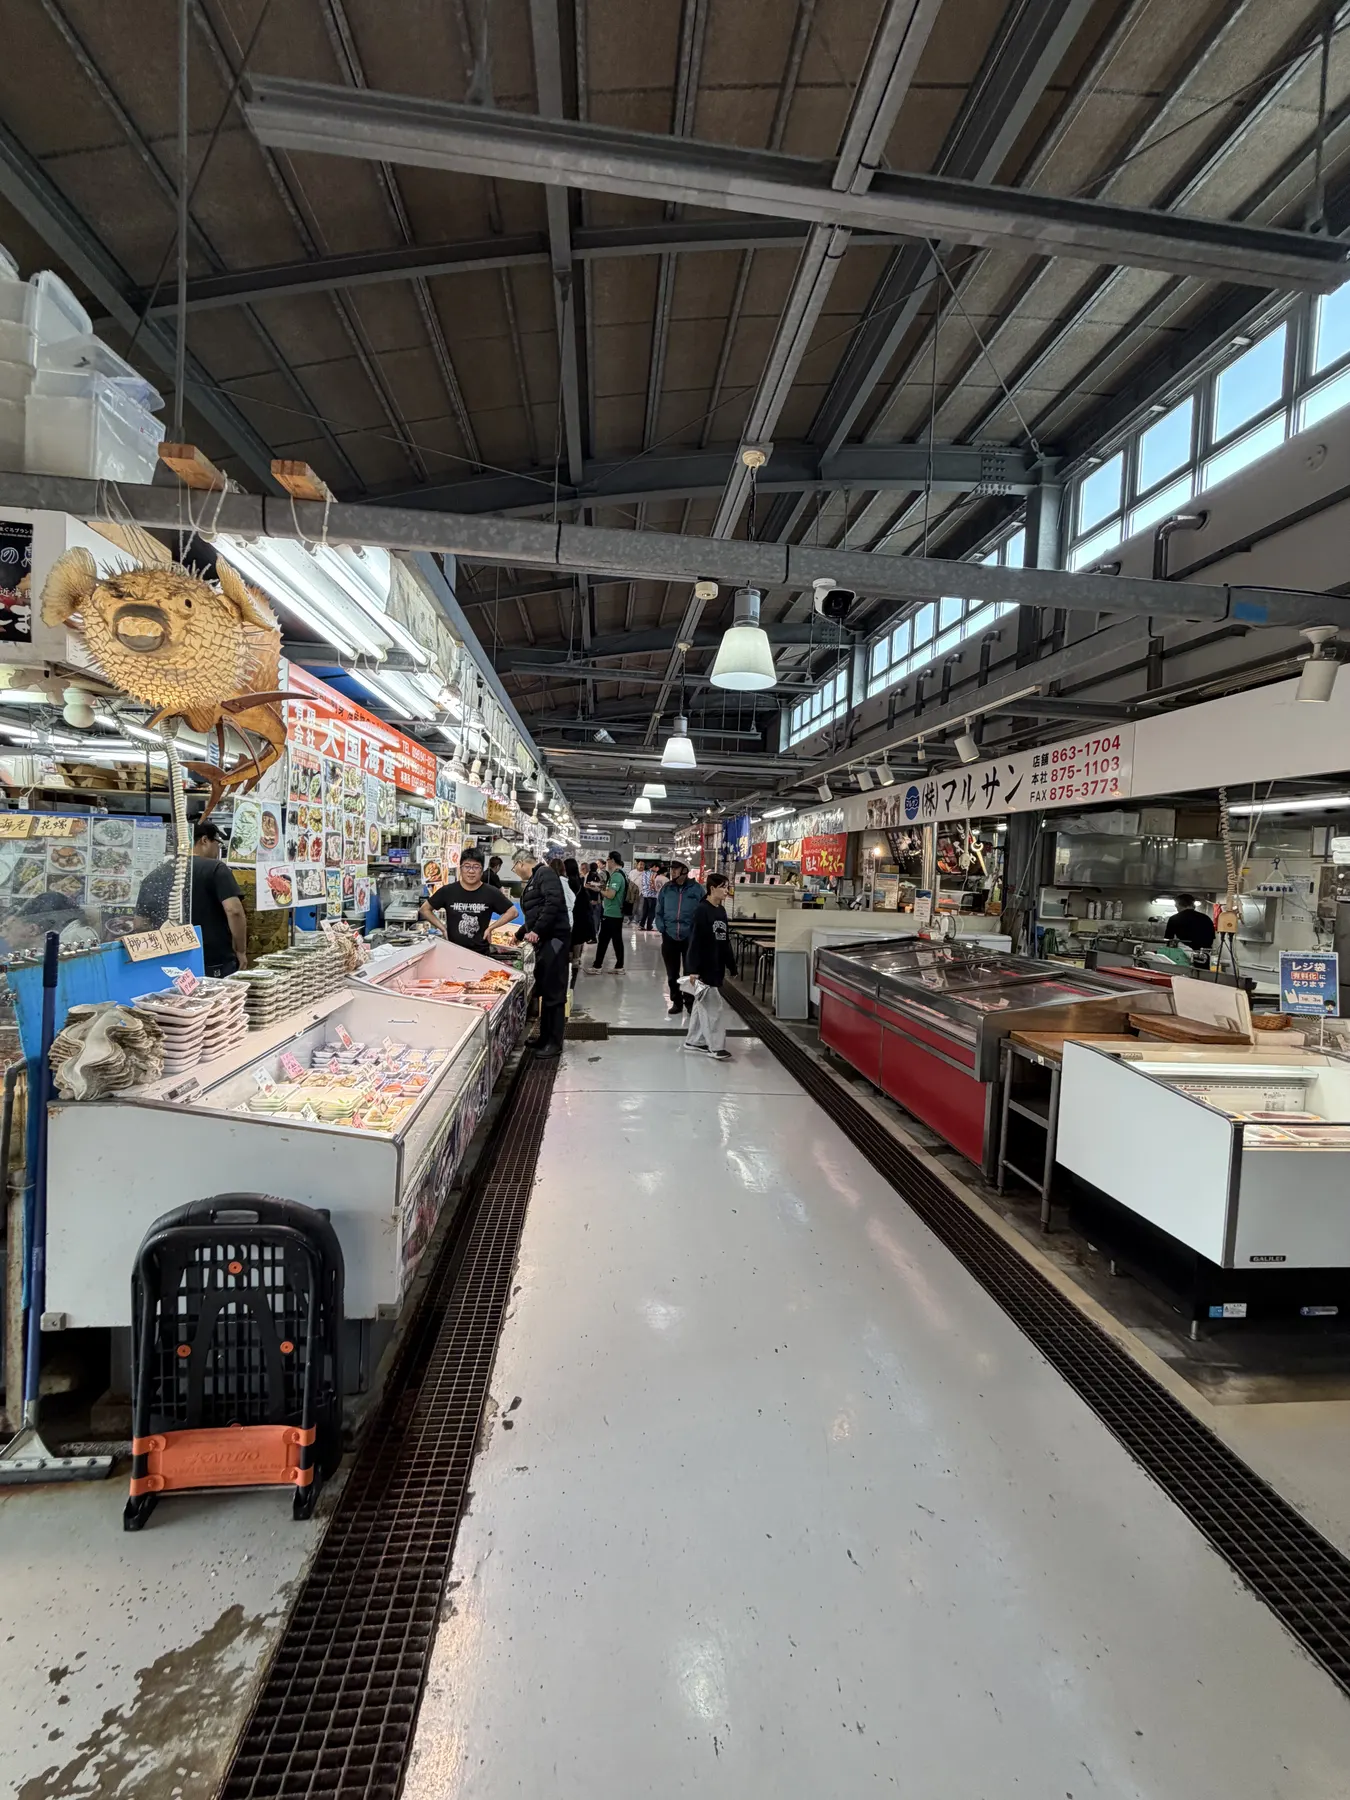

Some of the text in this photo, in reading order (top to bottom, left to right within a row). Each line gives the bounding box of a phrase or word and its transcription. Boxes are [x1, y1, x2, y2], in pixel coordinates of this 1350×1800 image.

[320, 718, 396, 781] 大国海産
[1032, 735, 1121, 768] 店舗 863-1704
[1031, 756, 1120, 785] 本社 875-1103
[1030, 777, 1119, 802] FAX 875-3773
[453, 902, 486, 911] NEW YORK
[1292, 961, 1327, 972] レジ袋
[1292, 980, 1327, 988] なります
